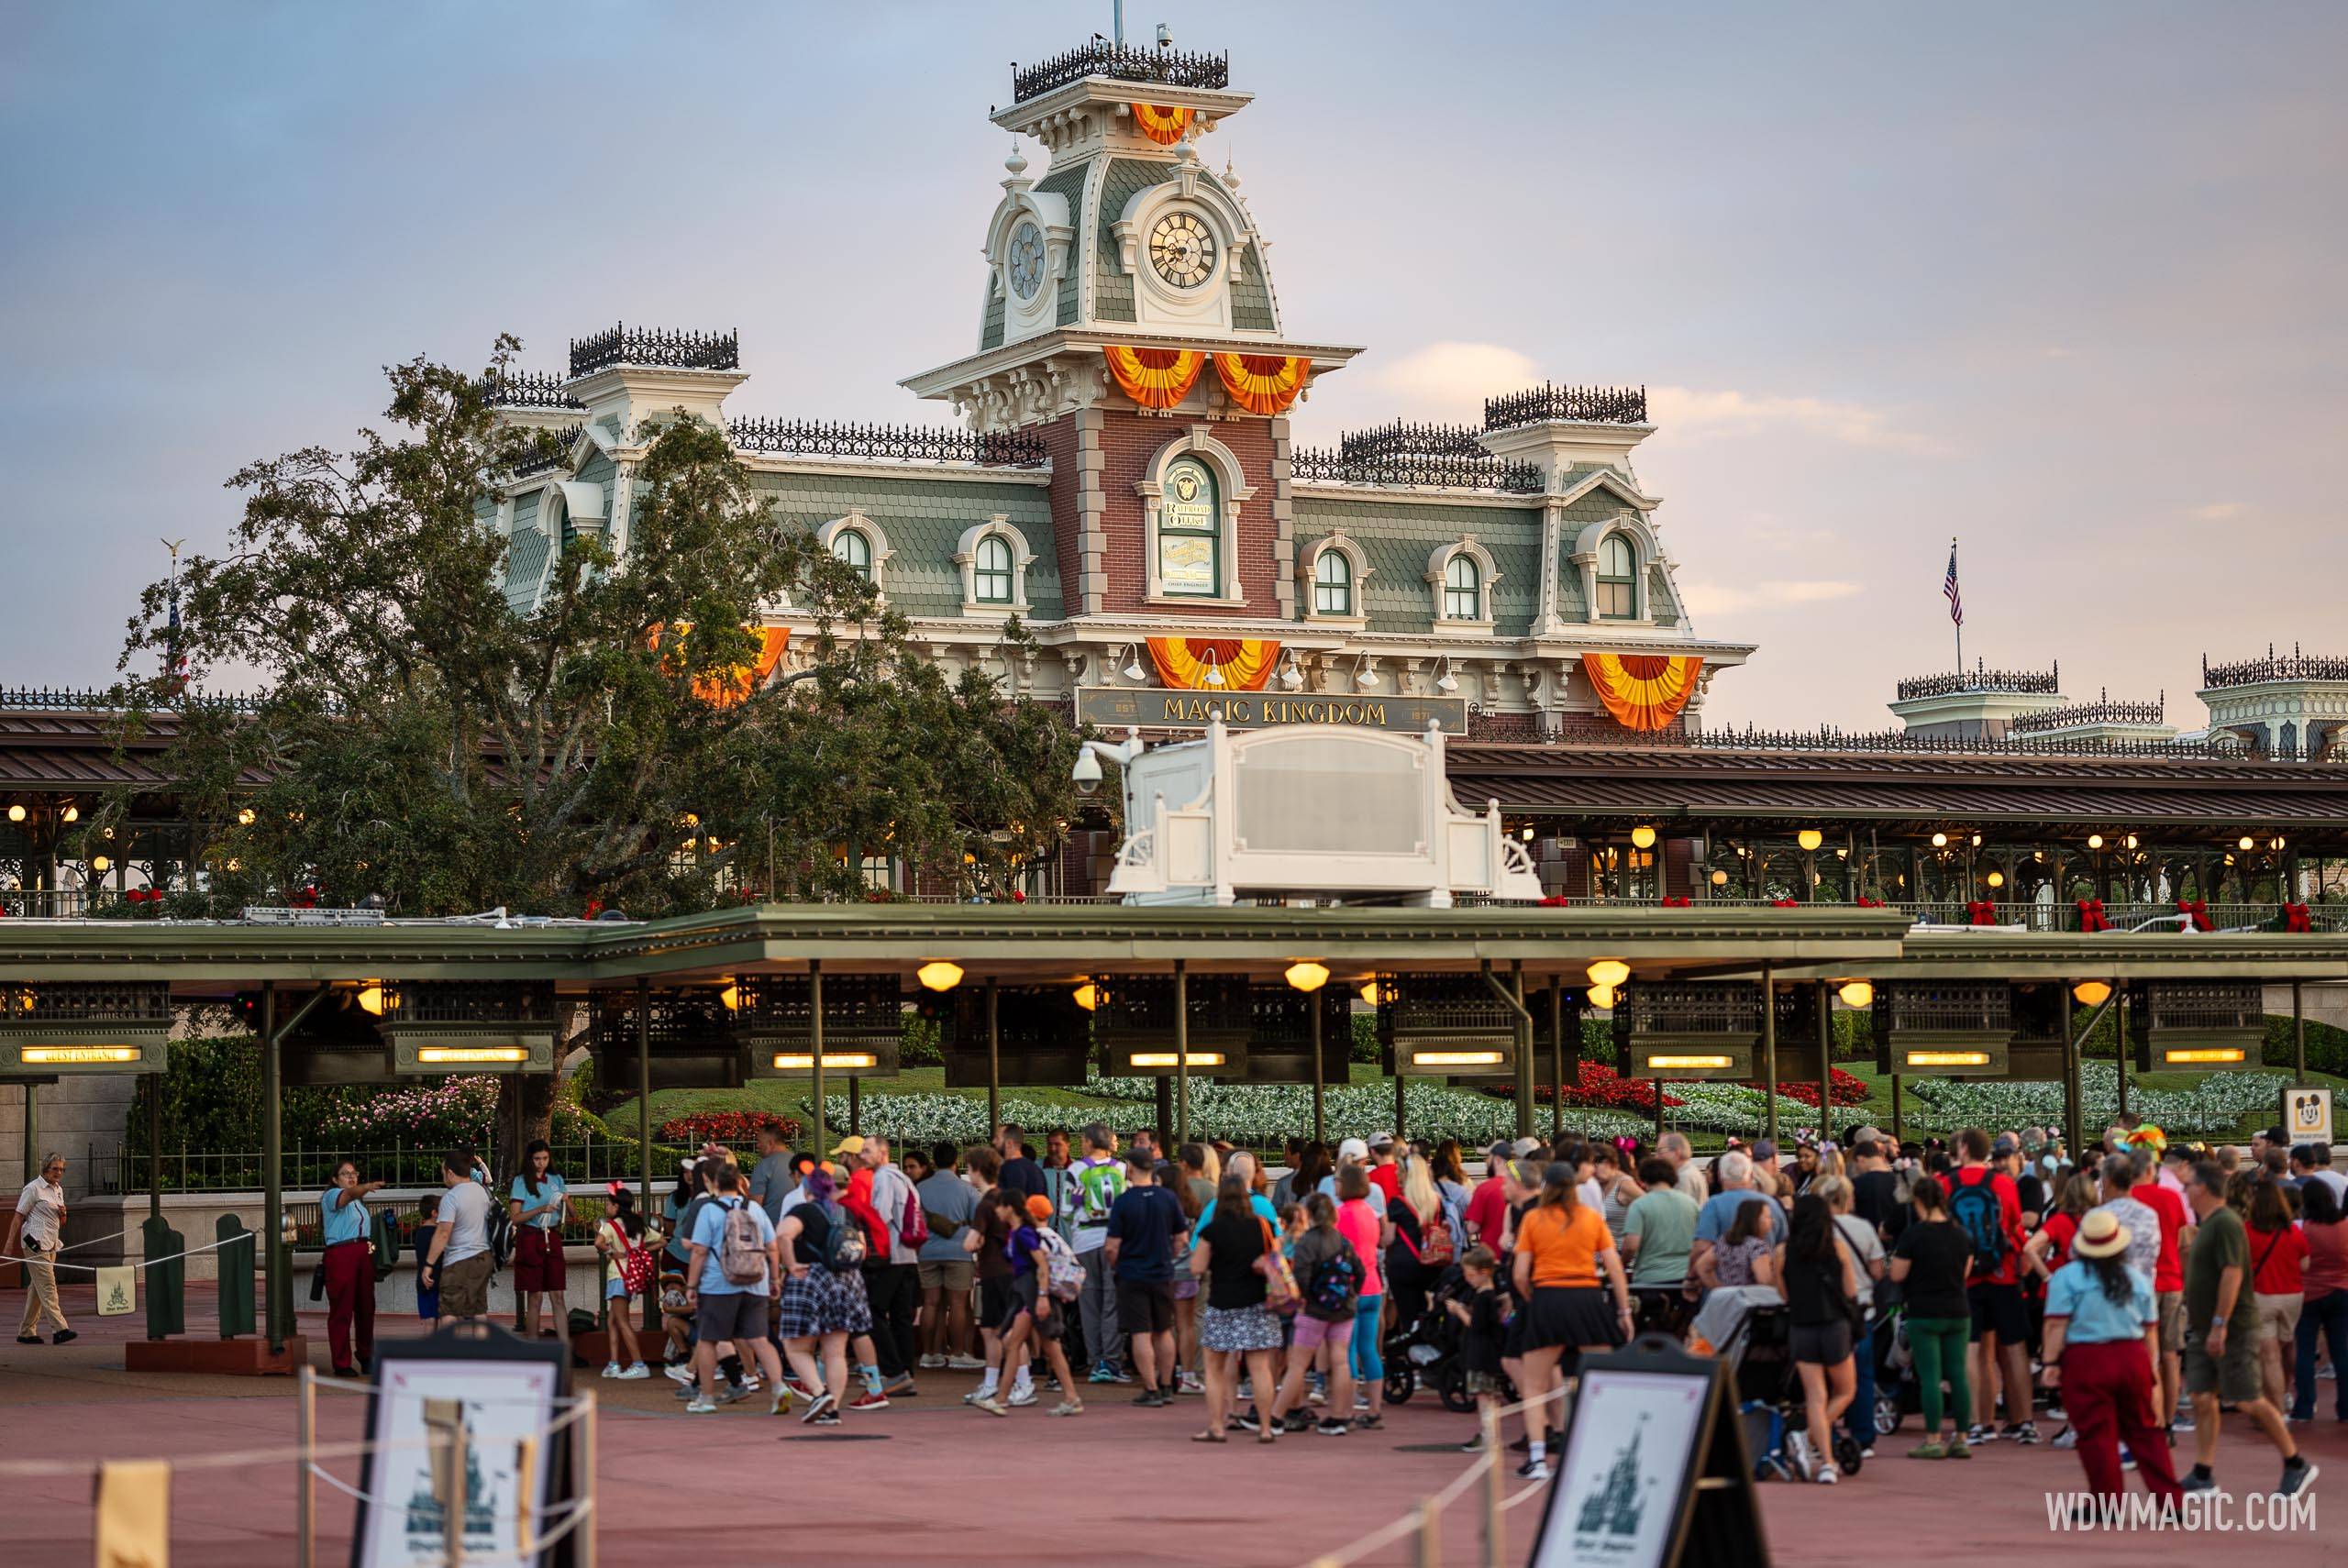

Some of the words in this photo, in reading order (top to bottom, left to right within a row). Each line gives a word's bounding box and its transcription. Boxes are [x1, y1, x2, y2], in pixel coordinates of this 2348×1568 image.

[1163, 698, 1250, 722] MAGIC
[1262, 701, 1386, 725] KINGDOM
[45, 1051, 72, 1061] GUEST
[74, 1049, 117, 1061] ENTRANCE
